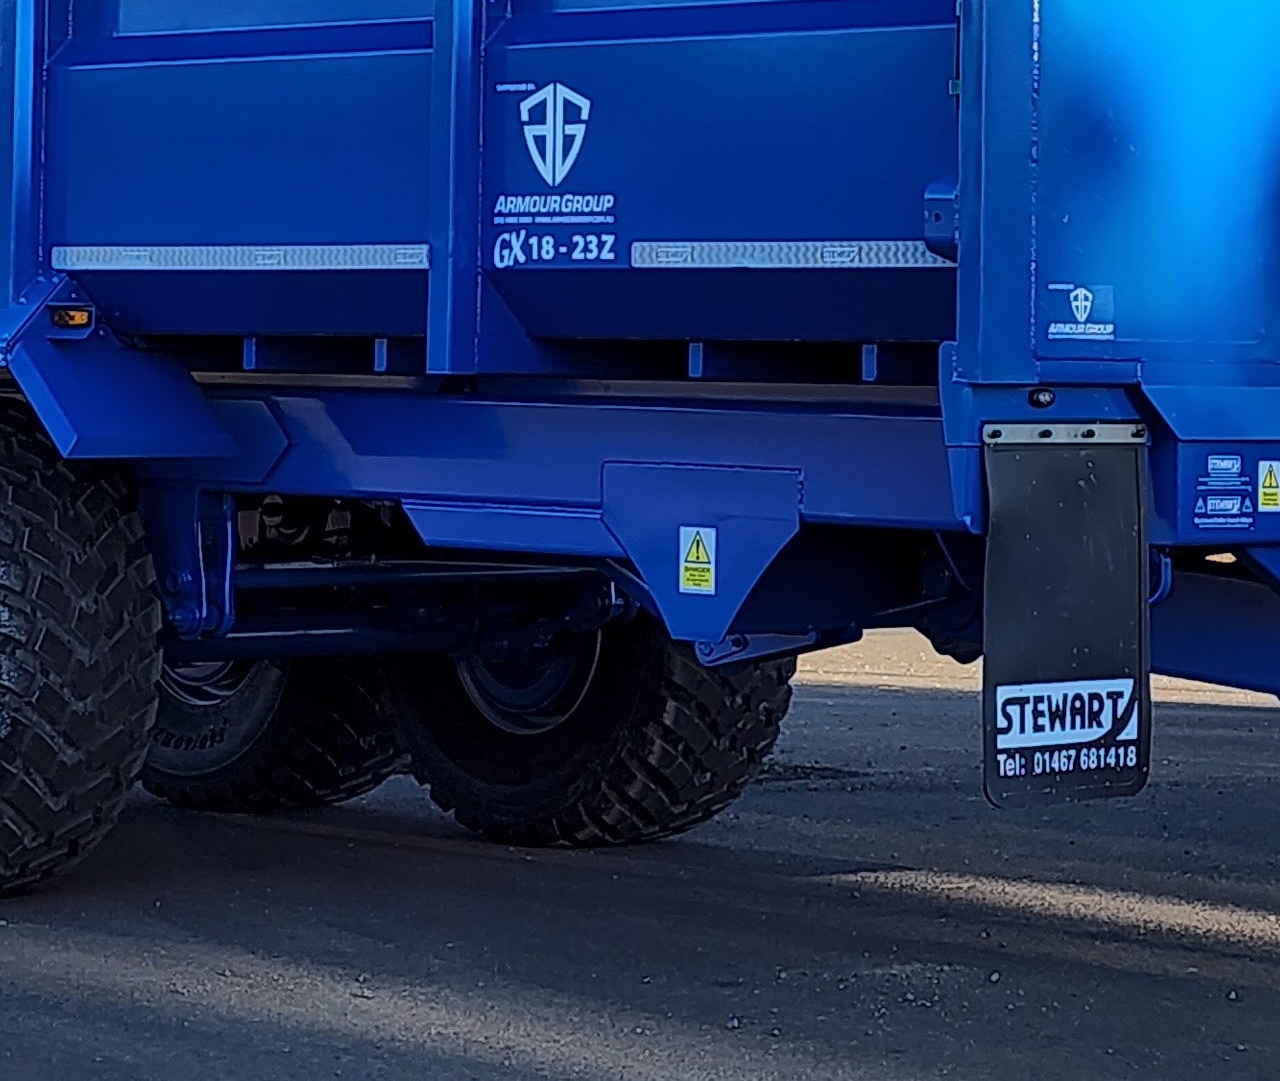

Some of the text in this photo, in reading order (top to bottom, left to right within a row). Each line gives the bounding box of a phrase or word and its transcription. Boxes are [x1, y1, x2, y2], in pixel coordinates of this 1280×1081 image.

[997, 687, 1137, 741] STEWART
[997, 745, 1137, 777] Tel: 01467 681418
